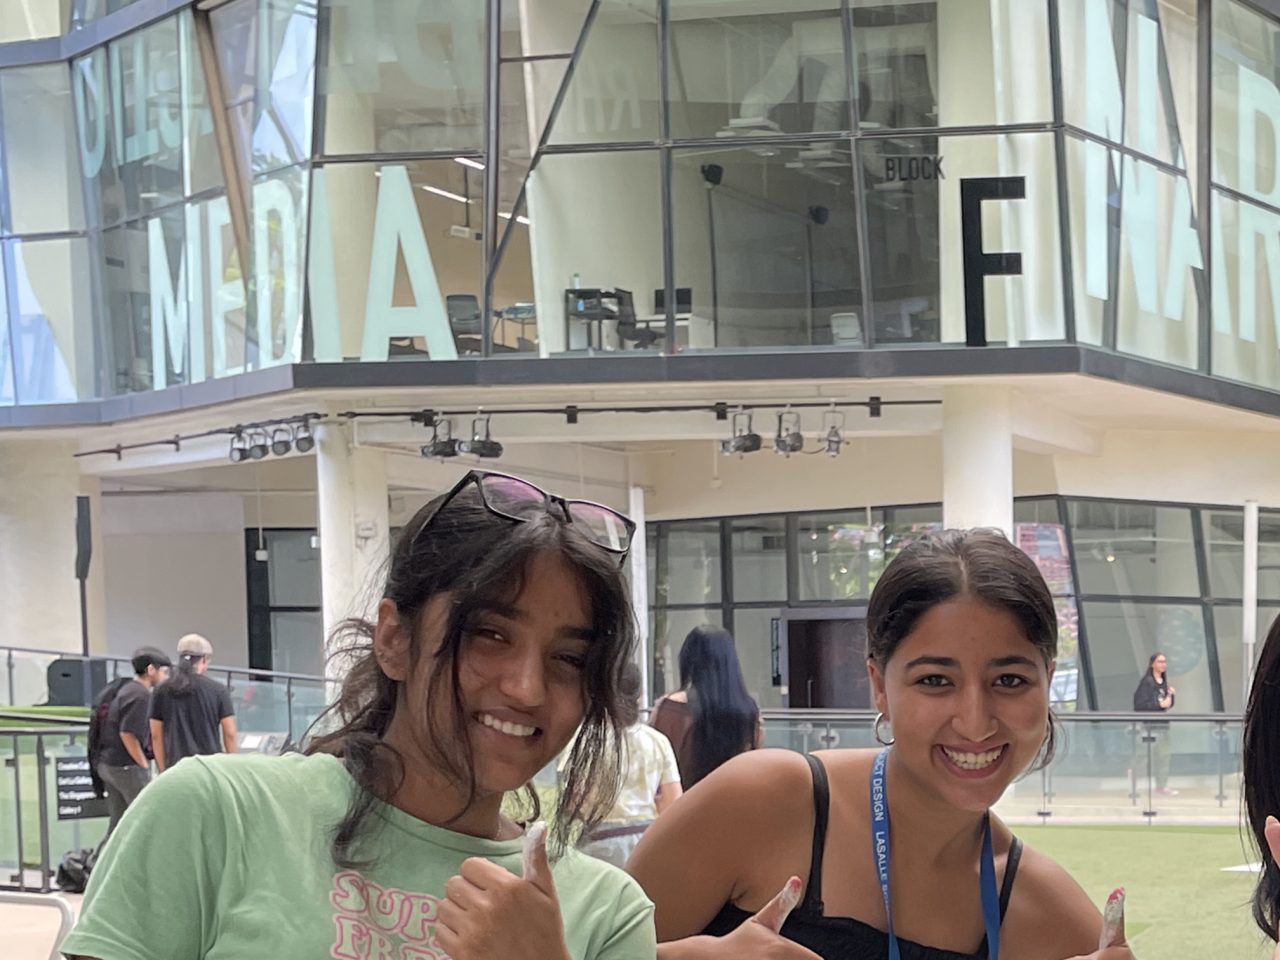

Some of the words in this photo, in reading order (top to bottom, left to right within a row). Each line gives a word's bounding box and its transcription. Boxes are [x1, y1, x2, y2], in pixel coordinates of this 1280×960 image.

[884, 156, 946, 181] BLOCK
[147, 164, 458, 391] MEDIA
[959, 175, 1026, 347] F
[872, 779, 884, 822] DESIGN
[875, 831, 888, 881] LASALLE
[329, 870, 445, 946] SUP
